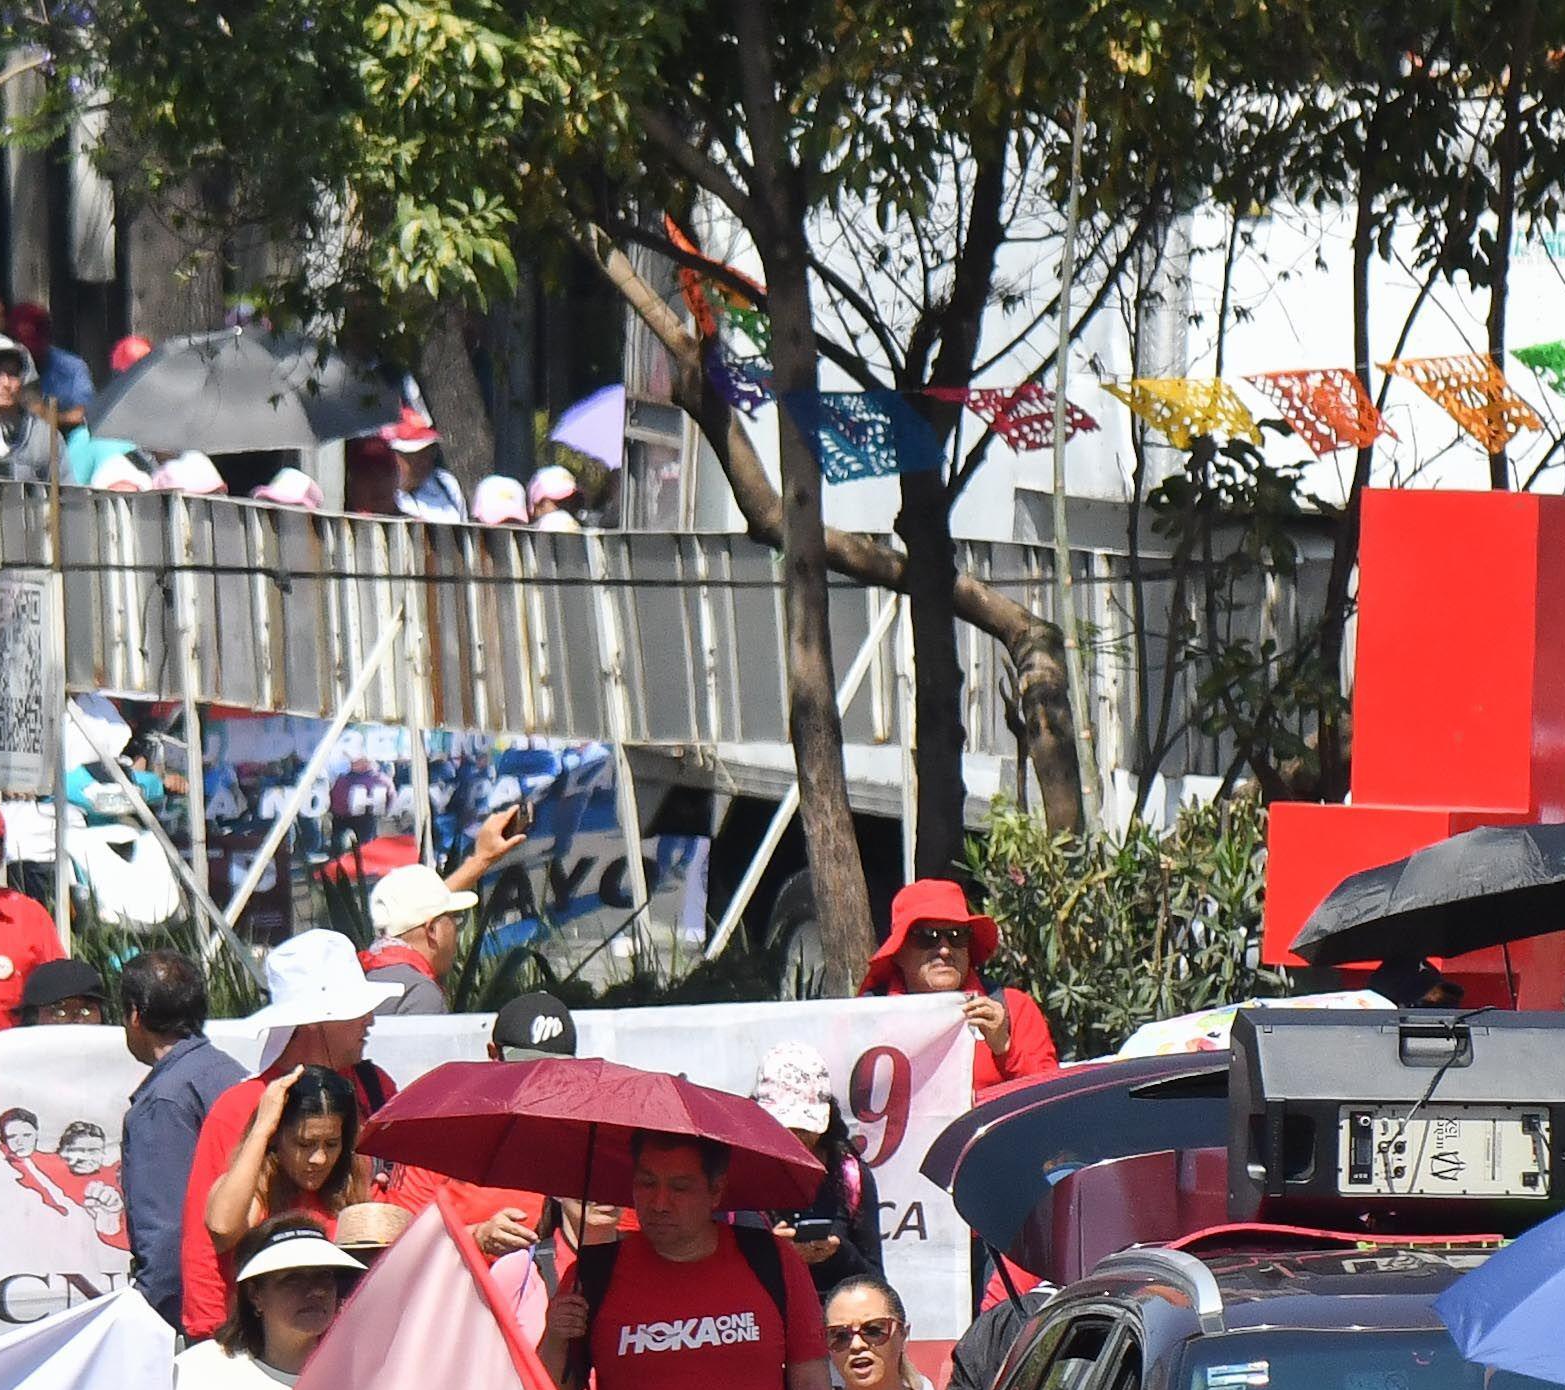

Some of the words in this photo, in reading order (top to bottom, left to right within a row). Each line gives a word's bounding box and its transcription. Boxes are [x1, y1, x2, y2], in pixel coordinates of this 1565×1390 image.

[848, 1045, 912, 1169] 9
[618, 1316, 721, 1356] HOKA
[716, 1312, 755, 1331] ONE
[721, 1325, 760, 1345] ONE
